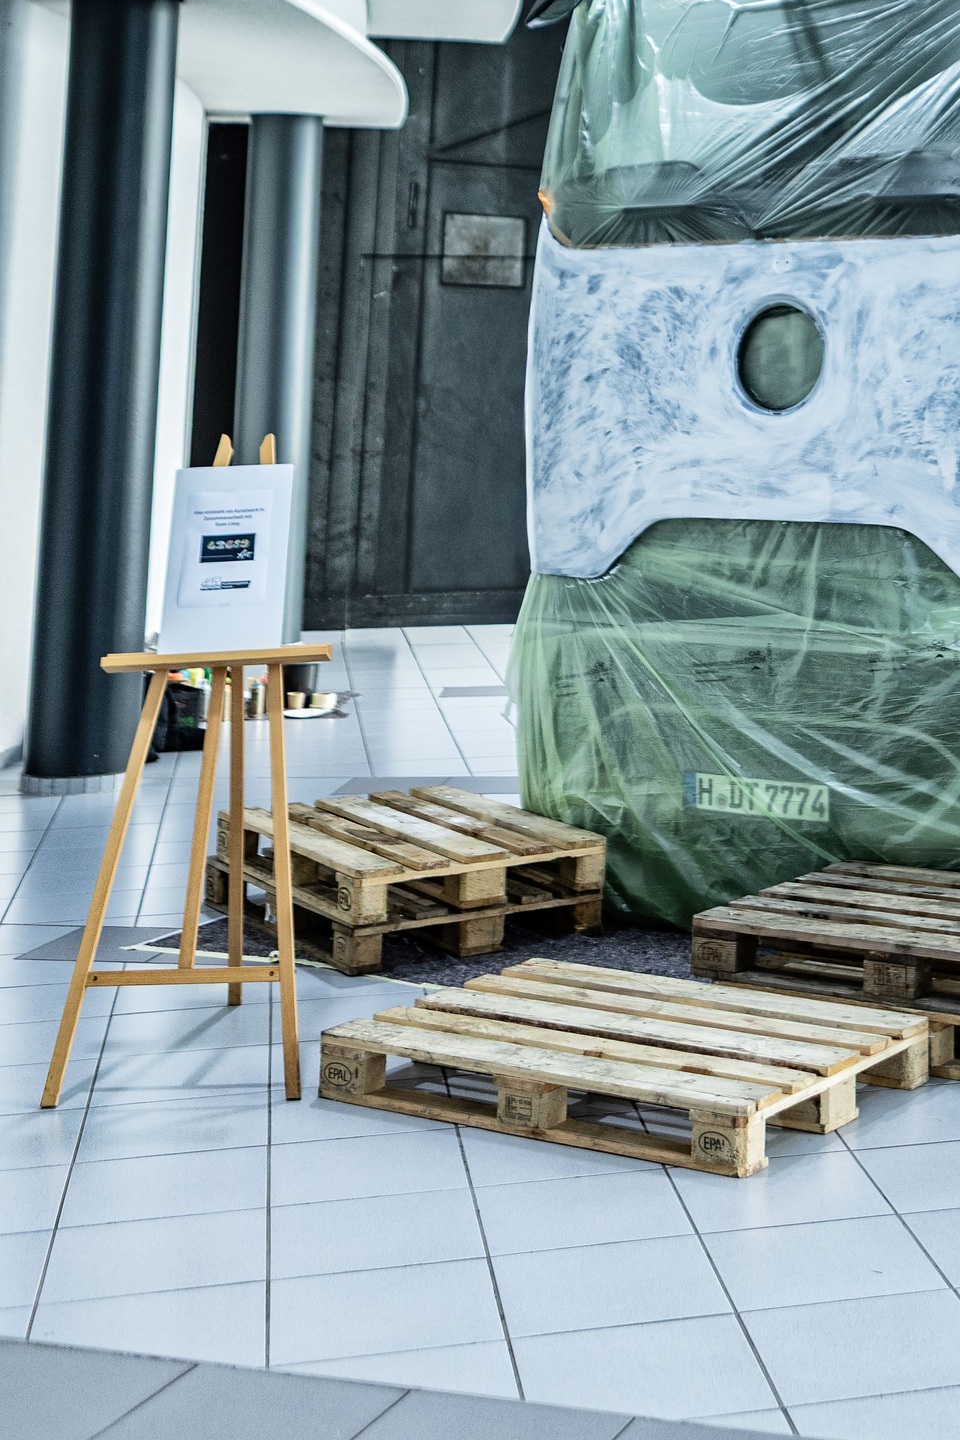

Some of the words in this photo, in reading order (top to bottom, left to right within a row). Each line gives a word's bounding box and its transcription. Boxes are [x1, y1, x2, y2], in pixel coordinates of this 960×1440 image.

[698, 777, 713, 806] H
[729, 780, 759, 810] DT
[765, 783, 826, 818] 7774
[328, 1066, 349, 1082] EPAL
